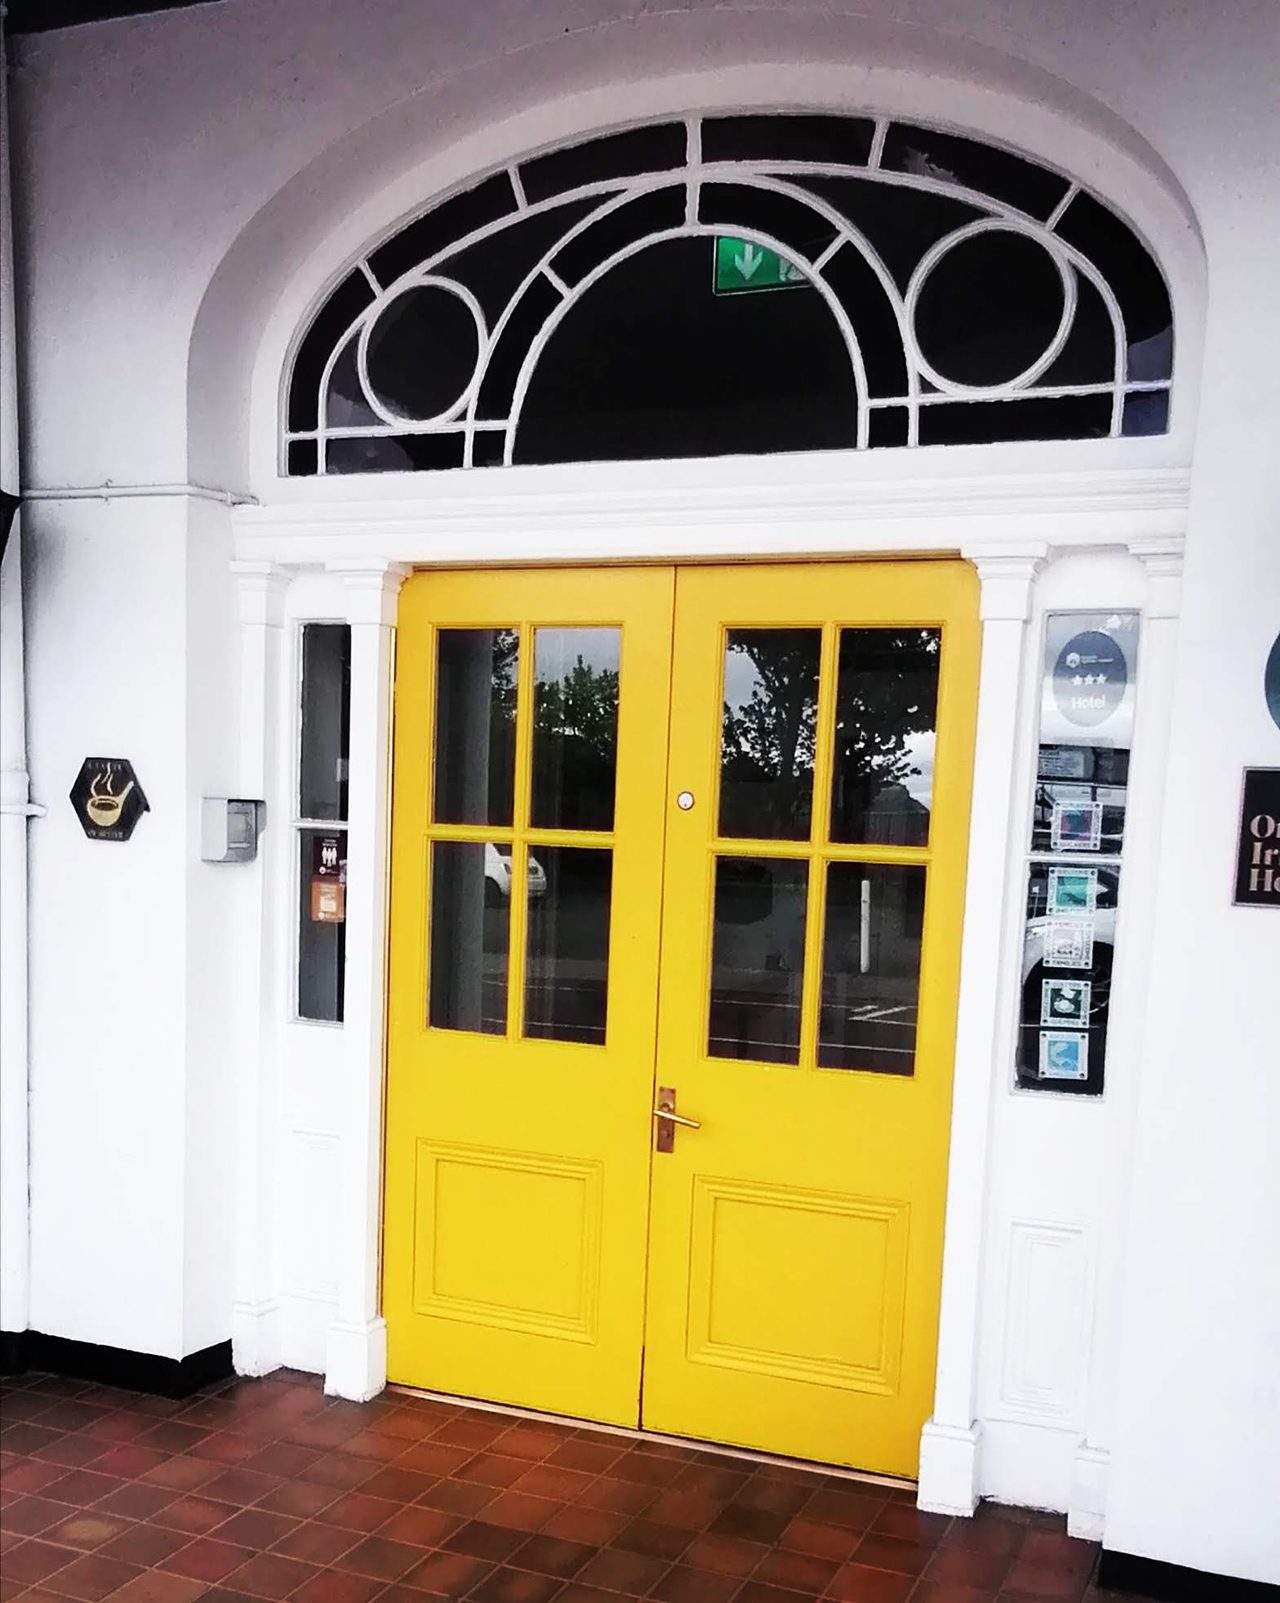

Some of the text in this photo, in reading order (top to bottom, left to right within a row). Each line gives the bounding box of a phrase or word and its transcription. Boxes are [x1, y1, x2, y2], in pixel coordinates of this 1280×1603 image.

[1071, 694, 1106, 709] Hotel
[1250, 814, 1280, 839] O
[1251, 842, 1280, 866] Ir
